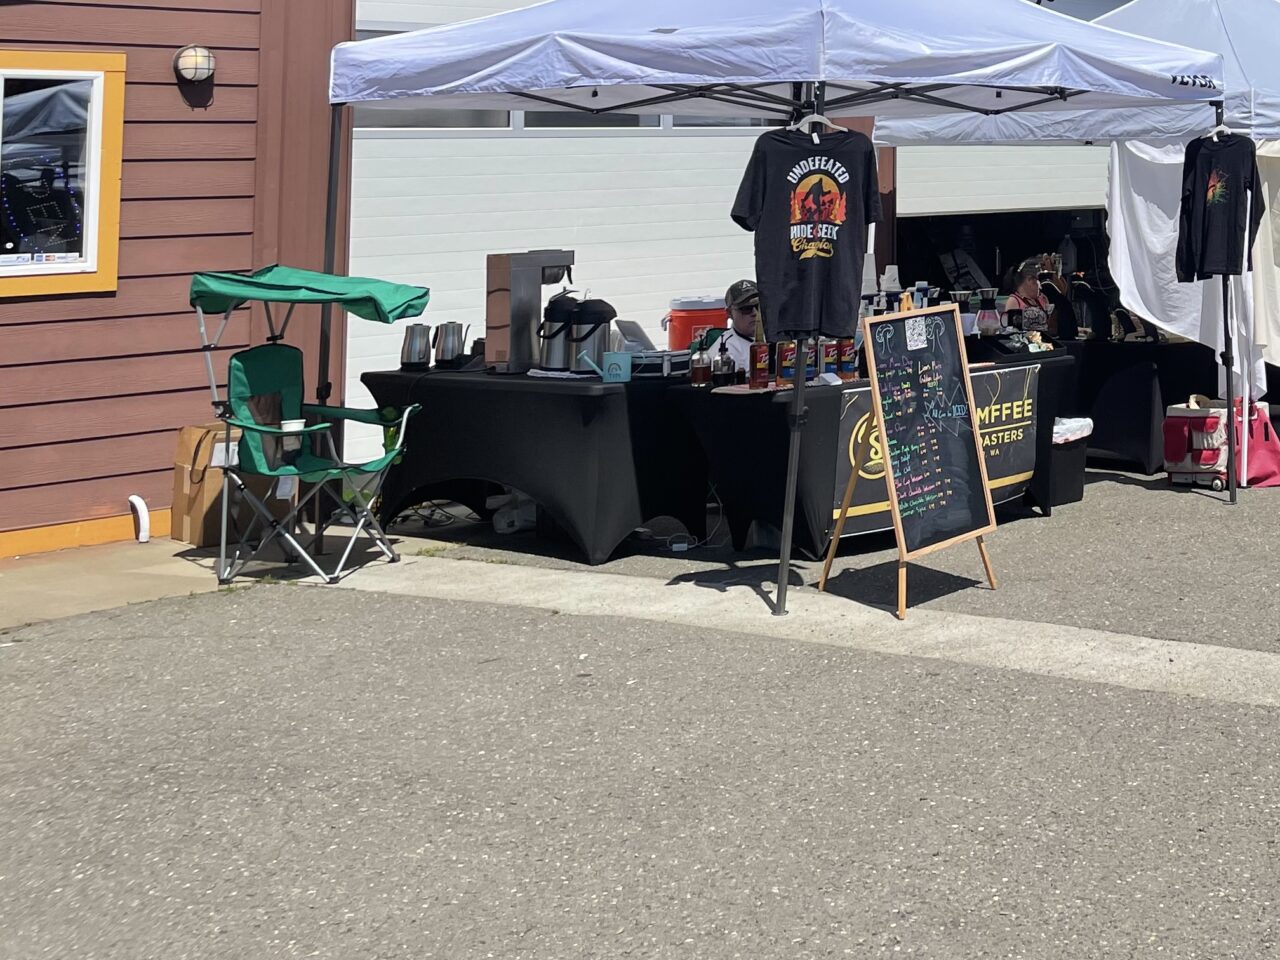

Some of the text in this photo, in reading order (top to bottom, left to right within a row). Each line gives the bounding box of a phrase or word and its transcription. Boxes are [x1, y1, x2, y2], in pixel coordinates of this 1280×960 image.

[787, 156, 850, 184] UNDEFEATED
[790, 224, 814, 240] HIDE
[817, 223, 840, 240] SEEK
[980, 429, 1024, 447] ASTERS
